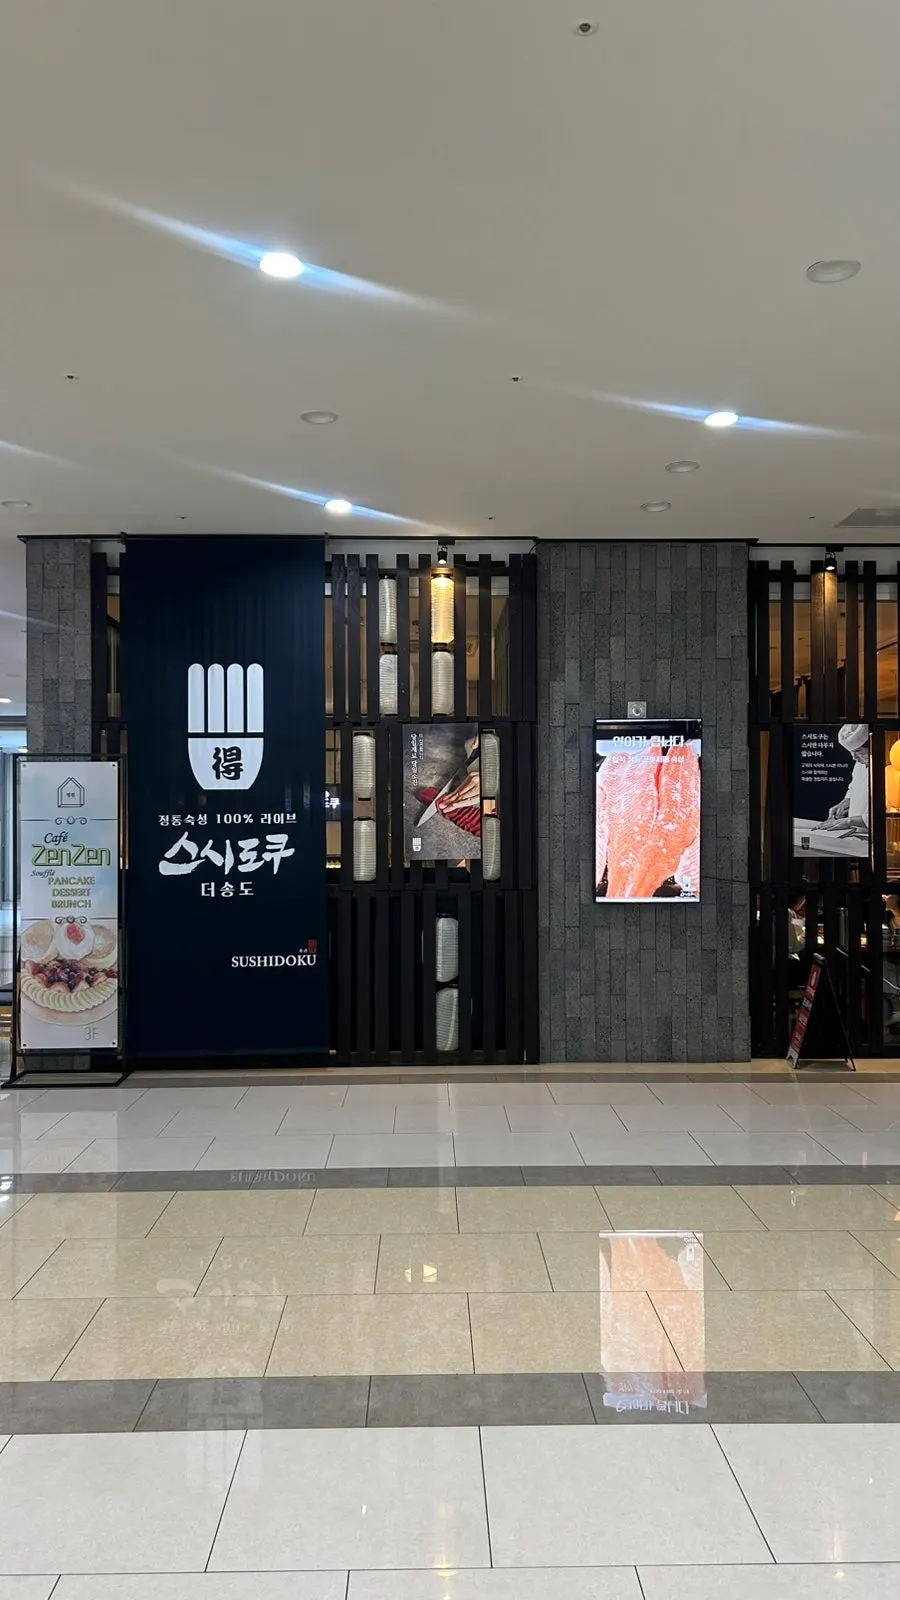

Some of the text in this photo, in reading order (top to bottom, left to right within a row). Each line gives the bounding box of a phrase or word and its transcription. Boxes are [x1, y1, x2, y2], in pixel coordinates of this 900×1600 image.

[801, 741, 834, 749] 스시만 다루지
[211, 745, 244, 781] 得
[158, 812, 297, 827] 정통숙성 100% 라이브
[44, 831, 69, 846] Café
[31, 843, 111, 867] ZenZen
[158, 831, 296, 876] 스시도쿠
[48, 876, 96, 886] PANCAKE
[52, 888, 91, 897] DESSERT
[51, 900, 92, 909] BRUNCH
[231, 954, 317, 968] SUSHIDOKU
[84, 1026, 98, 1041] 3F
